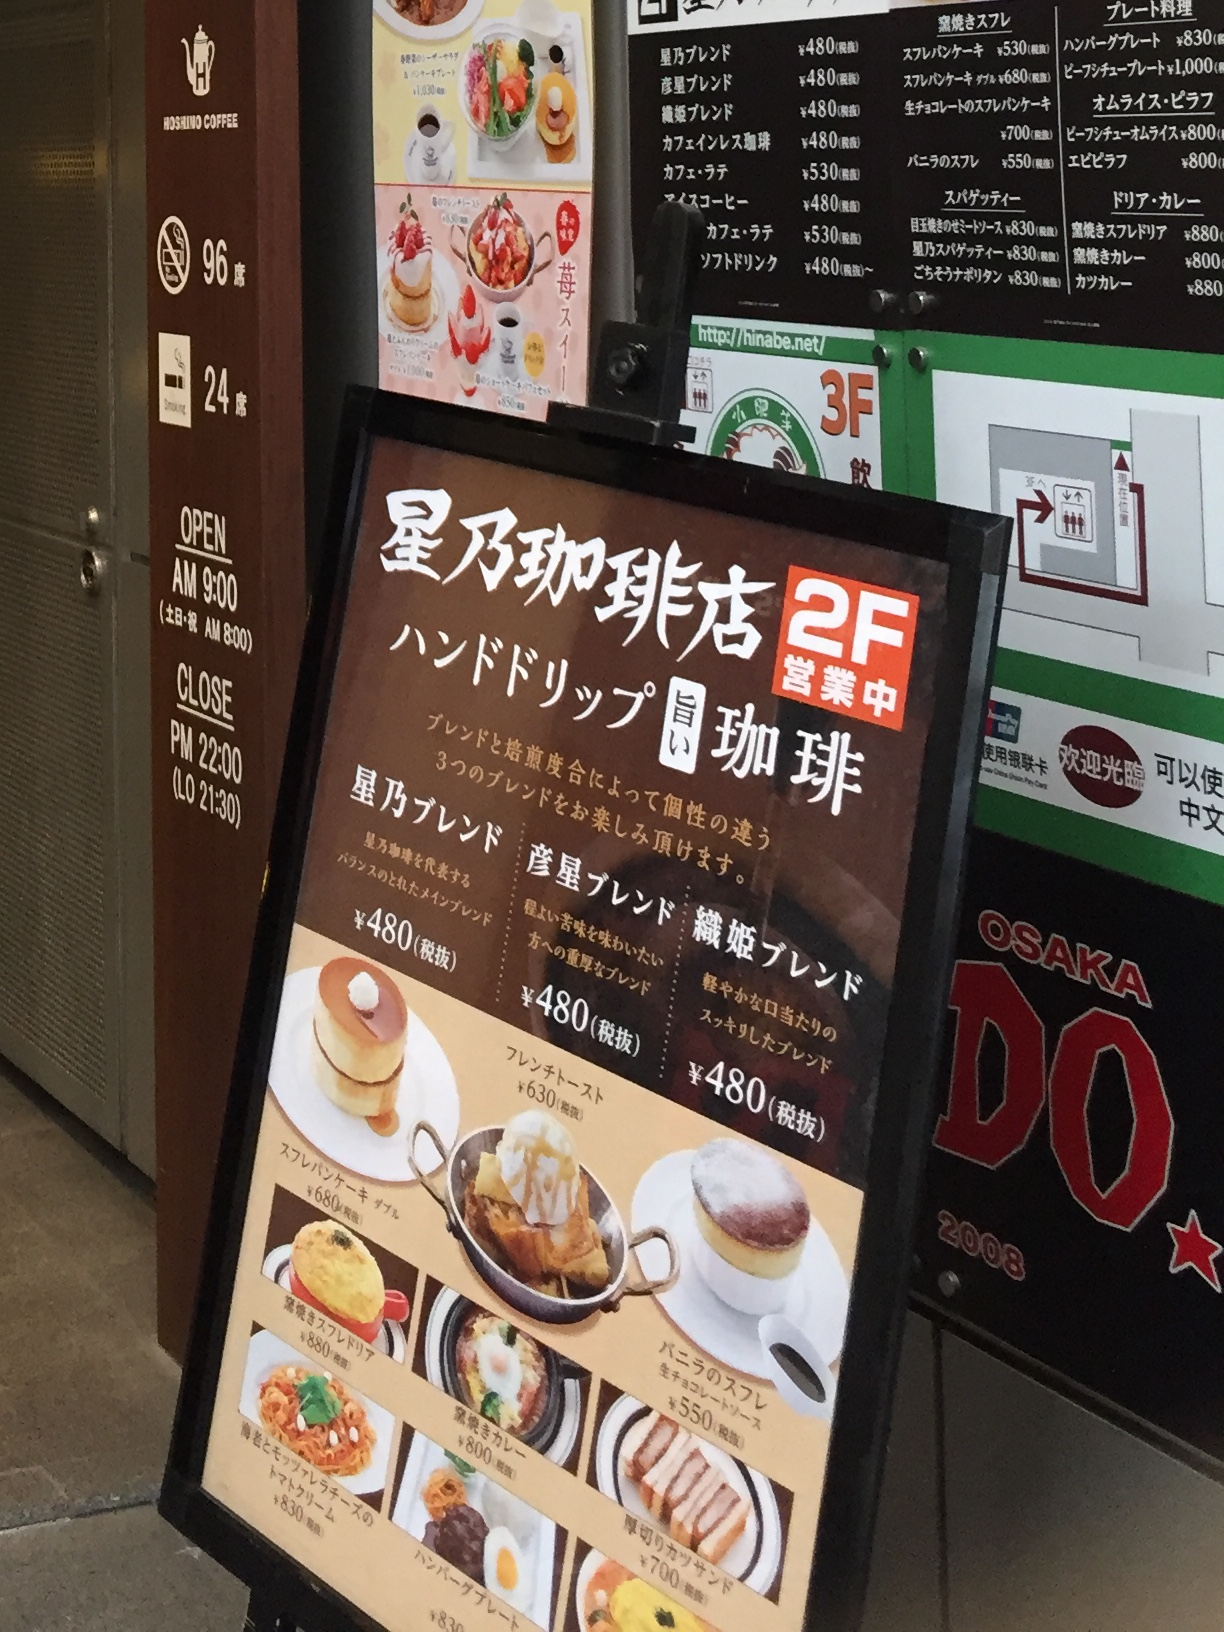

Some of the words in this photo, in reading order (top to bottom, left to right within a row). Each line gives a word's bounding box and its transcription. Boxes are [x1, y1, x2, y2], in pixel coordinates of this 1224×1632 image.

[660, 44, 732, 66] 星乃ブレンド
[903, 42, 984, 61] スフレパンケーキ
[1063, 31, 1161, 52] ハンバーグプレート
[1064, 59, 1165, 79] ビーフシチュープレート
[661, 74, 733, 96] 彦星ブレンド
[904, 70, 973, 88] スフレパンケーキ
[904, 95, 1051, 116] 生チョコレートのスフレパンケーキ
[1093, 89, 1214, 112] オムライス・ピラフ
[163, 114, 202, 131] HOSHINO
[203, 113, 238, 129] COFFEE
[662, 131, 771, 152] カフェインレス珈琲
[1066, 125, 1178, 142] ビーフシチューオムライス
[663, 163, 729, 180] カフェ・ラテ
[907, 154, 979, 169] バニラのスフレ
[1067, 152, 1128, 169] エビピラフ
[910, 217, 1003, 235] 目玉焼きのせミートソース
[944, 189, 1021, 207] スパゲッティー
[1113, 191, 1201, 210] ドリア・カレー
[203, 238, 228, 286] 96
[700, 252, 778, 272] ソフトドリンク
[912, 240, 1004, 260] 星乃スパゲッティー
[914, 264, 1003, 284] ごちそうナポリタン
[1075, 273, 1133, 291] カツカレー
[557, 261, 578, 393] 苺スイー
[698, 324, 826, 356] http://hinabe.net/
[204, 364, 229, 415] 24
[820, 369, 873, 438] 3F
[180, 506, 226, 555] OPEN
[172, 556, 197, 600] AM
[203, 566, 238, 612] 9:00
[380, 488, 776, 662] 星乃珈琲店
[787, 577, 909, 666] 2F
[204, 616, 220, 643] AM
[223, 622, 252, 654] 8:00)
[177, 662, 233, 720] CLOSE
[782, 654, 898, 718] 営業中
[389, 623, 656, 730] ハンドドリップ
[668, 694, 697, 757] 旨い
[711, 701, 866, 817] 珈琲
[171, 718, 193, 763] PM
[199, 731, 242, 784] 22:00
[1059, 744, 1145, 791] 欢迎光臨
[1154, 752, 1224, 799] 可以使
[172, 766, 195, 804] (LO
[200, 780, 241, 829] 21:30)
[350, 764, 503, 854] 星乃ブレンド
[427, 713, 770, 851] ブレンドと焙煎度合によって個性の違う
[1179, 797, 1224, 836] 中文
[363, 831, 471, 888] 星乃珈琲を代表する
[526, 842, 676, 926] 彦星ブレンド
[337, 852, 493, 927] バランスのとれたメインブレンド
[353, 907, 457, 973] ¥480(税抜)
[524, 898, 664, 968] 程よい苦味を味わいたい
[692, 904, 863, 1001] 織姫ブレンド
[978, 909, 1152, 1008] OSAKA
[528, 931, 652, 996] 方への重厚なブレンド
[521, 984, 641, 1058] ¥480(税抜)
[702, 971, 837, 1043] 軽やかな口当たりの
[700, 1008, 832, 1074] スッキリしたブレンド
[505, 1045, 605, 1106] フレンチトースト
[688, 1060, 826, 1143] ¥480(税抜)
[932, 959, 1174, 1232] DO
[279, 1142, 369, 1202] スフレパンケーキ
[937, 1209, 1025, 1281] 2008
[658, 1362, 762, 1431] 生チョコレートソース
[659, 1340, 769, 1410] バニラのスフレ
[268, 1462, 335, 1525] トマトクリーム
[624, 1513, 734, 1596] 厚切りカツサンド
[414, 1548, 520, 1632] ハンバーグプレート
